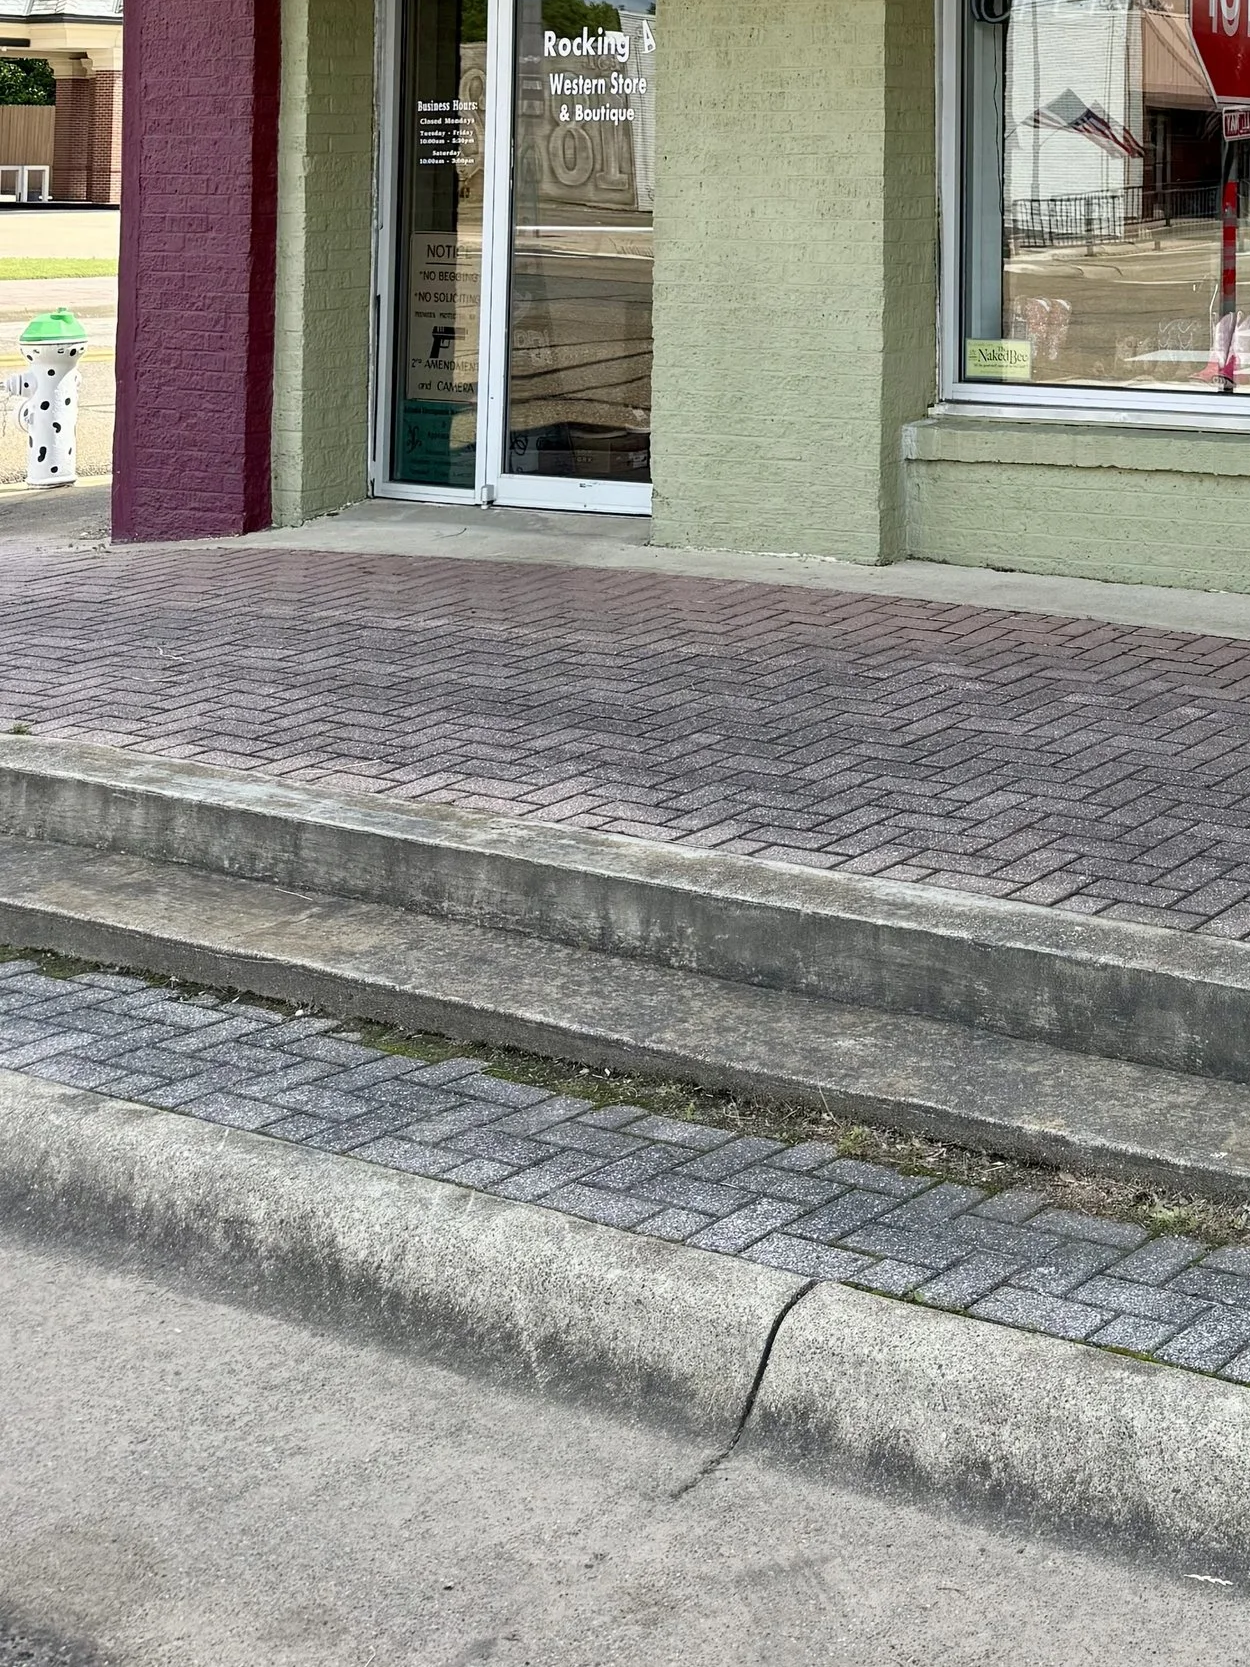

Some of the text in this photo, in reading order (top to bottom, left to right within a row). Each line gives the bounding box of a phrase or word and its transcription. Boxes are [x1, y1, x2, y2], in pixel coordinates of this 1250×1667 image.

[544, 26, 630, 63] Rocking
[549, 71, 647, 95] Western Store
[417, 99, 478, 112] Business Hours:
[444, 117, 475, 125] Mondays
[559, 103, 635, 126] & Boutique
[426, 244, 473, 260] NOTICE
[438, 271, 479, 283] BEGGING
[433, 292, 480, 304] SOLICITING
[418, 380, 474, 394] and CAMERA
